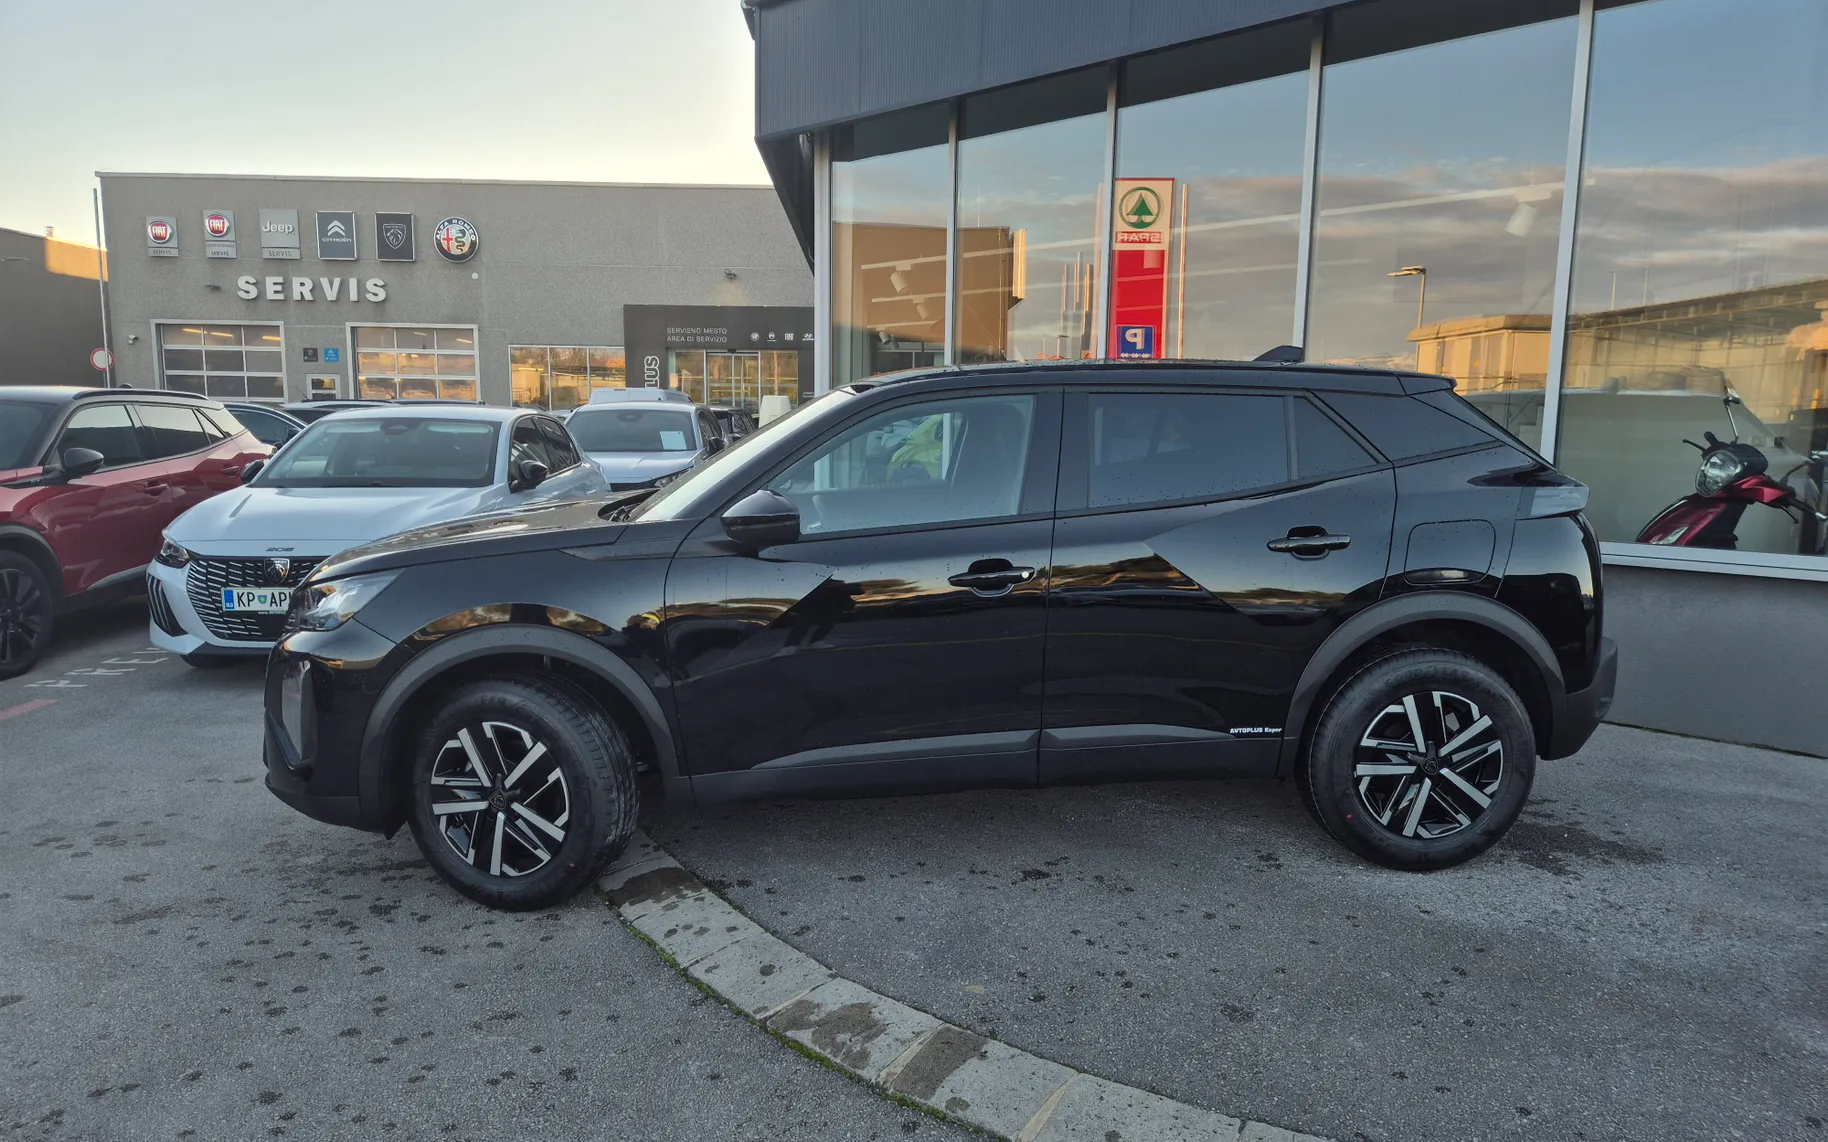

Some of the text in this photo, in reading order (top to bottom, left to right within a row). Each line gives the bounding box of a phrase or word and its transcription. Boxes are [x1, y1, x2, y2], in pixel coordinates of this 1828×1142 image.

[209, 219, 224, 231] FIAT
[262, 221, 294, 235] Jeep
[436, 218, 476, 241] ALFA ROMEO
[152, 226, 167, 238] FIAT
[237, 275, 387, 303] SERVIS
[703, 327, 728, 335] MESTO
[696, 335, 728, 343] SERVIZIO
[237, 591, 293, 607] KP AP
